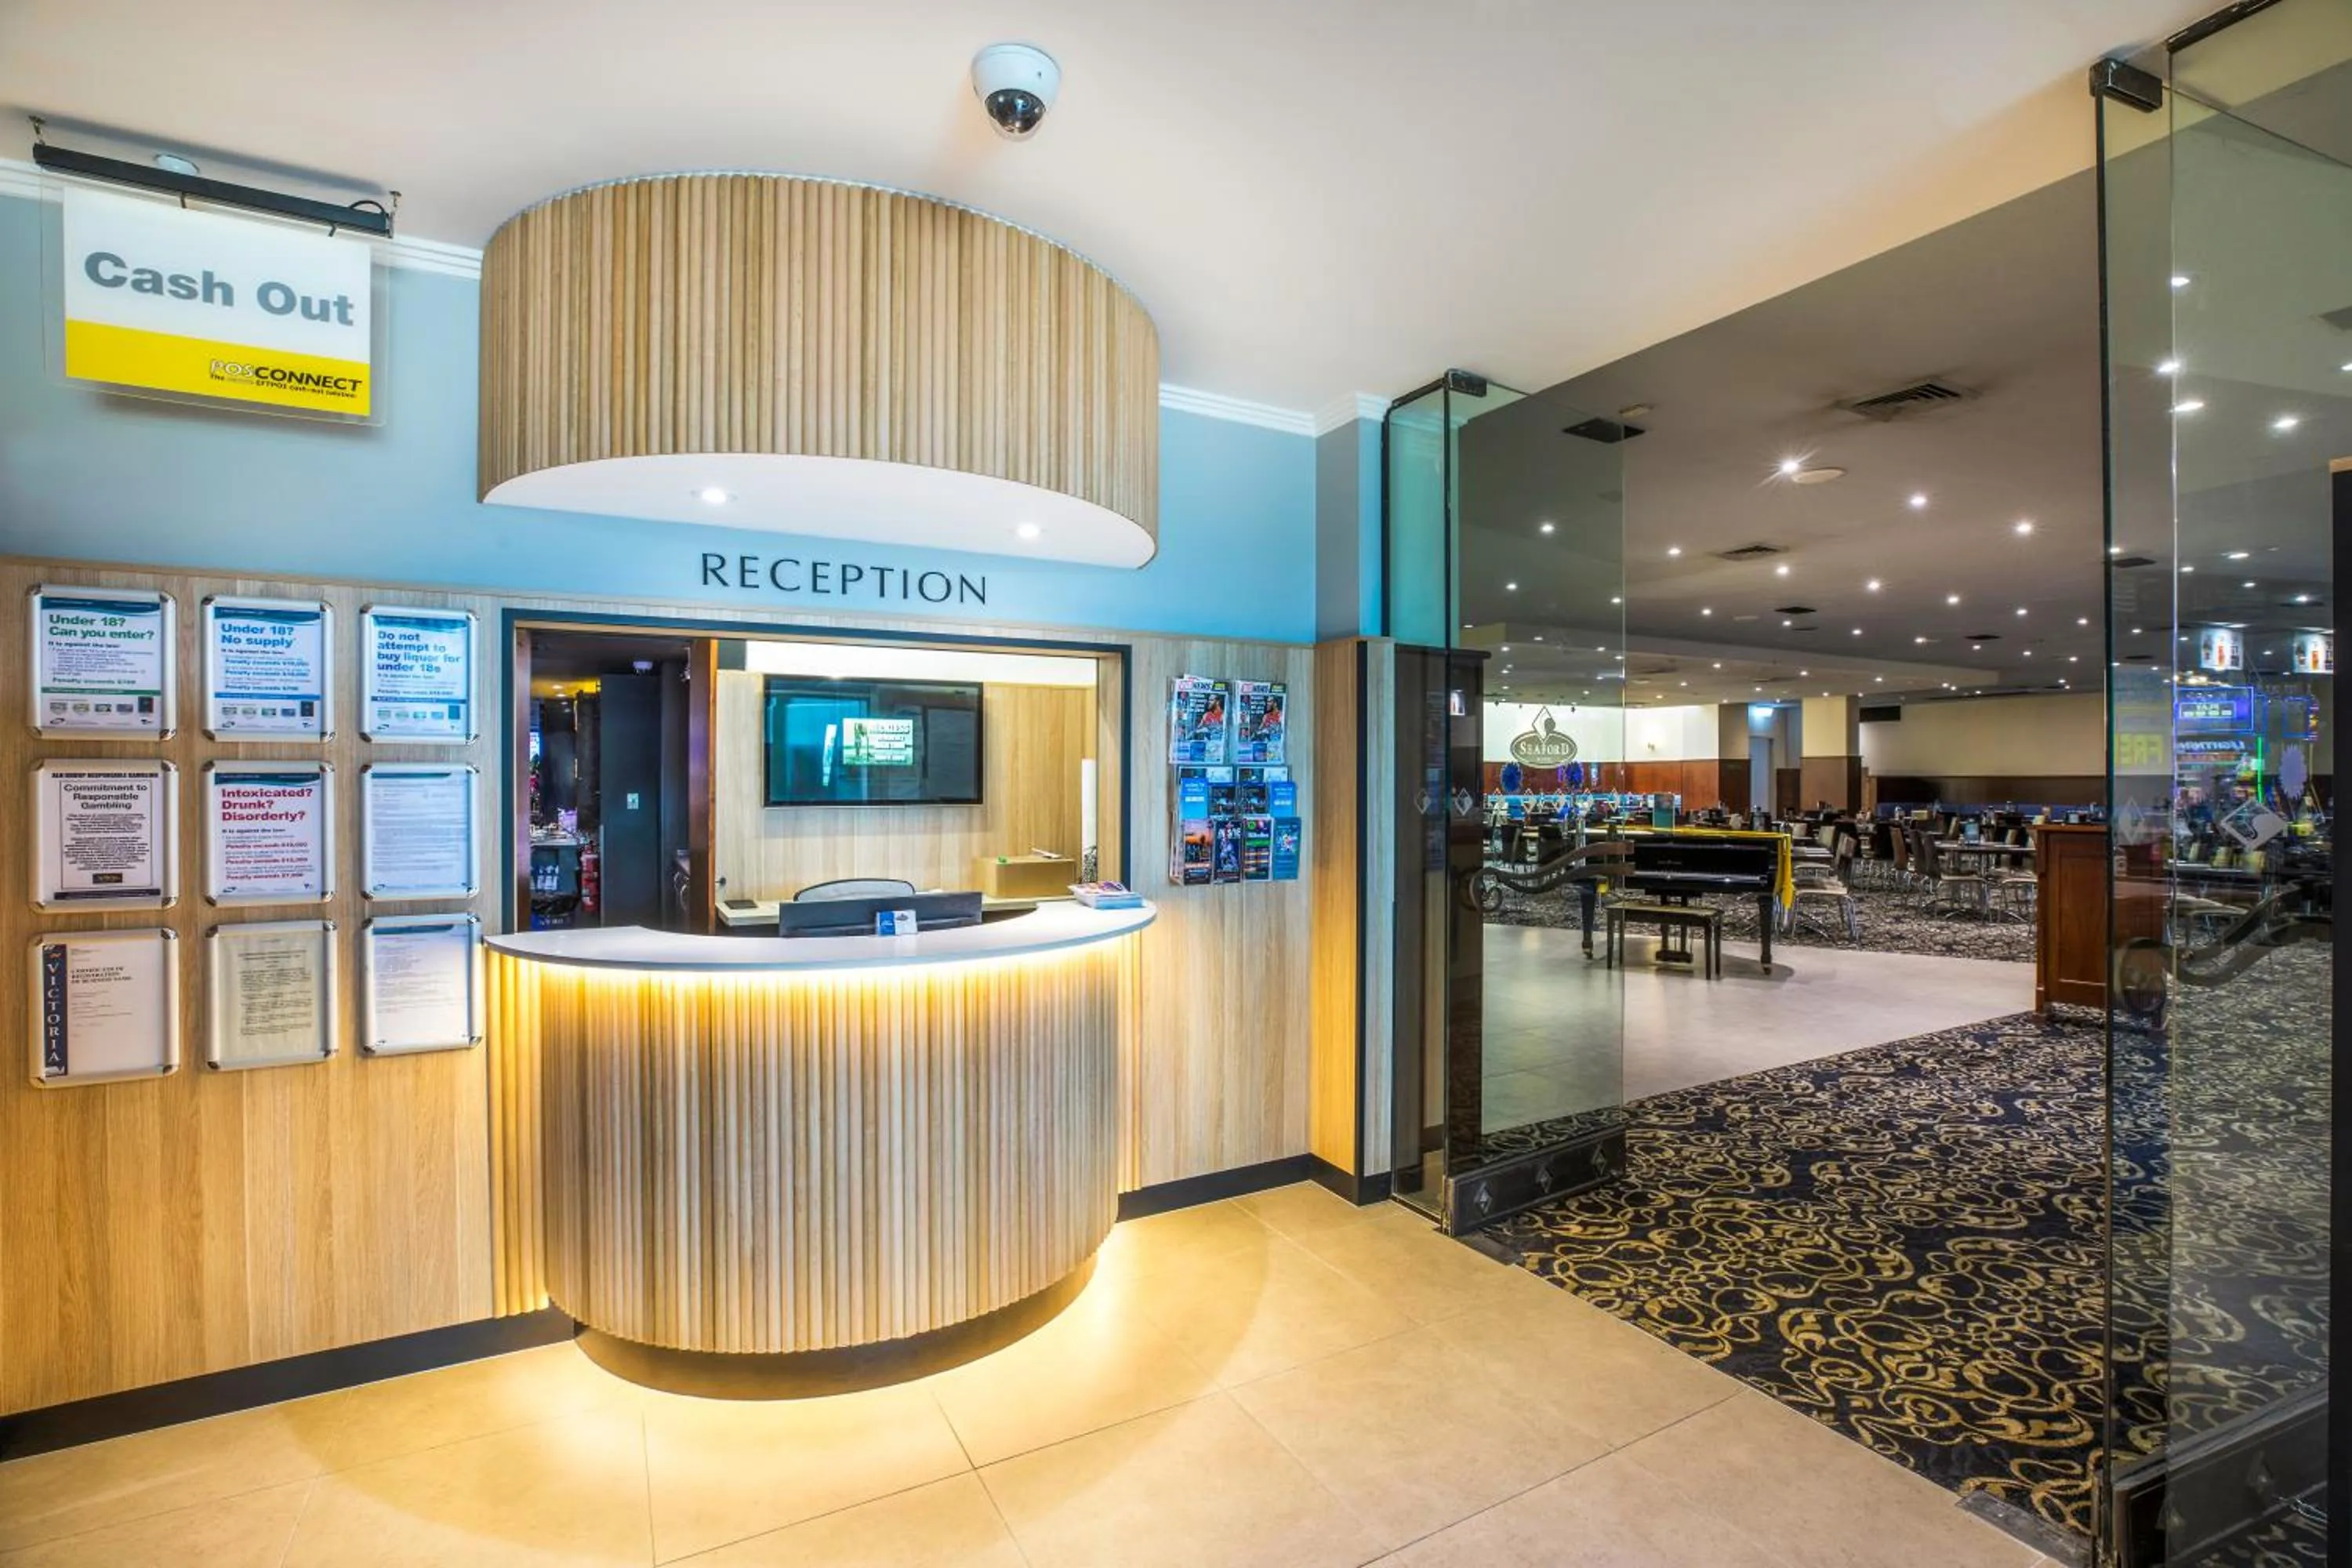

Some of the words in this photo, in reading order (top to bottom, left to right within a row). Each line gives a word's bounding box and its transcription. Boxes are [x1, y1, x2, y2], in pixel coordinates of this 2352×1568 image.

[85, 251, 234, 307] Cash
[256, 281, 354, 326] Out
[702, 553, 985, 604] RECEPTION
[49, 614, 96, 625] Under
[100, 616, 126, 627] 18?
[49, 626, 77, 636] Can
[81, 630, 105, 639] you
[109, 630, 154, 640] enter?
[221, 623, 265, 633] Under
[270, 625, 294, 635] 18?
[221, 634, 241, 644] No
[378, 631, 395, 640] Do
[377, 641, 429, 652] attempt
[377, 652, 401, 662] buy
[404, 652, 439, 662] liquor
[443, 654, 461, 662] for
[377, 662, 415, 672] under
[73, 793, 139, 801] Responsible
[222, 788, 313, 797] Intoxicated?
[222, 800, 274, 809] Drunk?
[222, 811, 306, 822] Disorderly?
[47, 964, 60, 1063] VICTORIA
